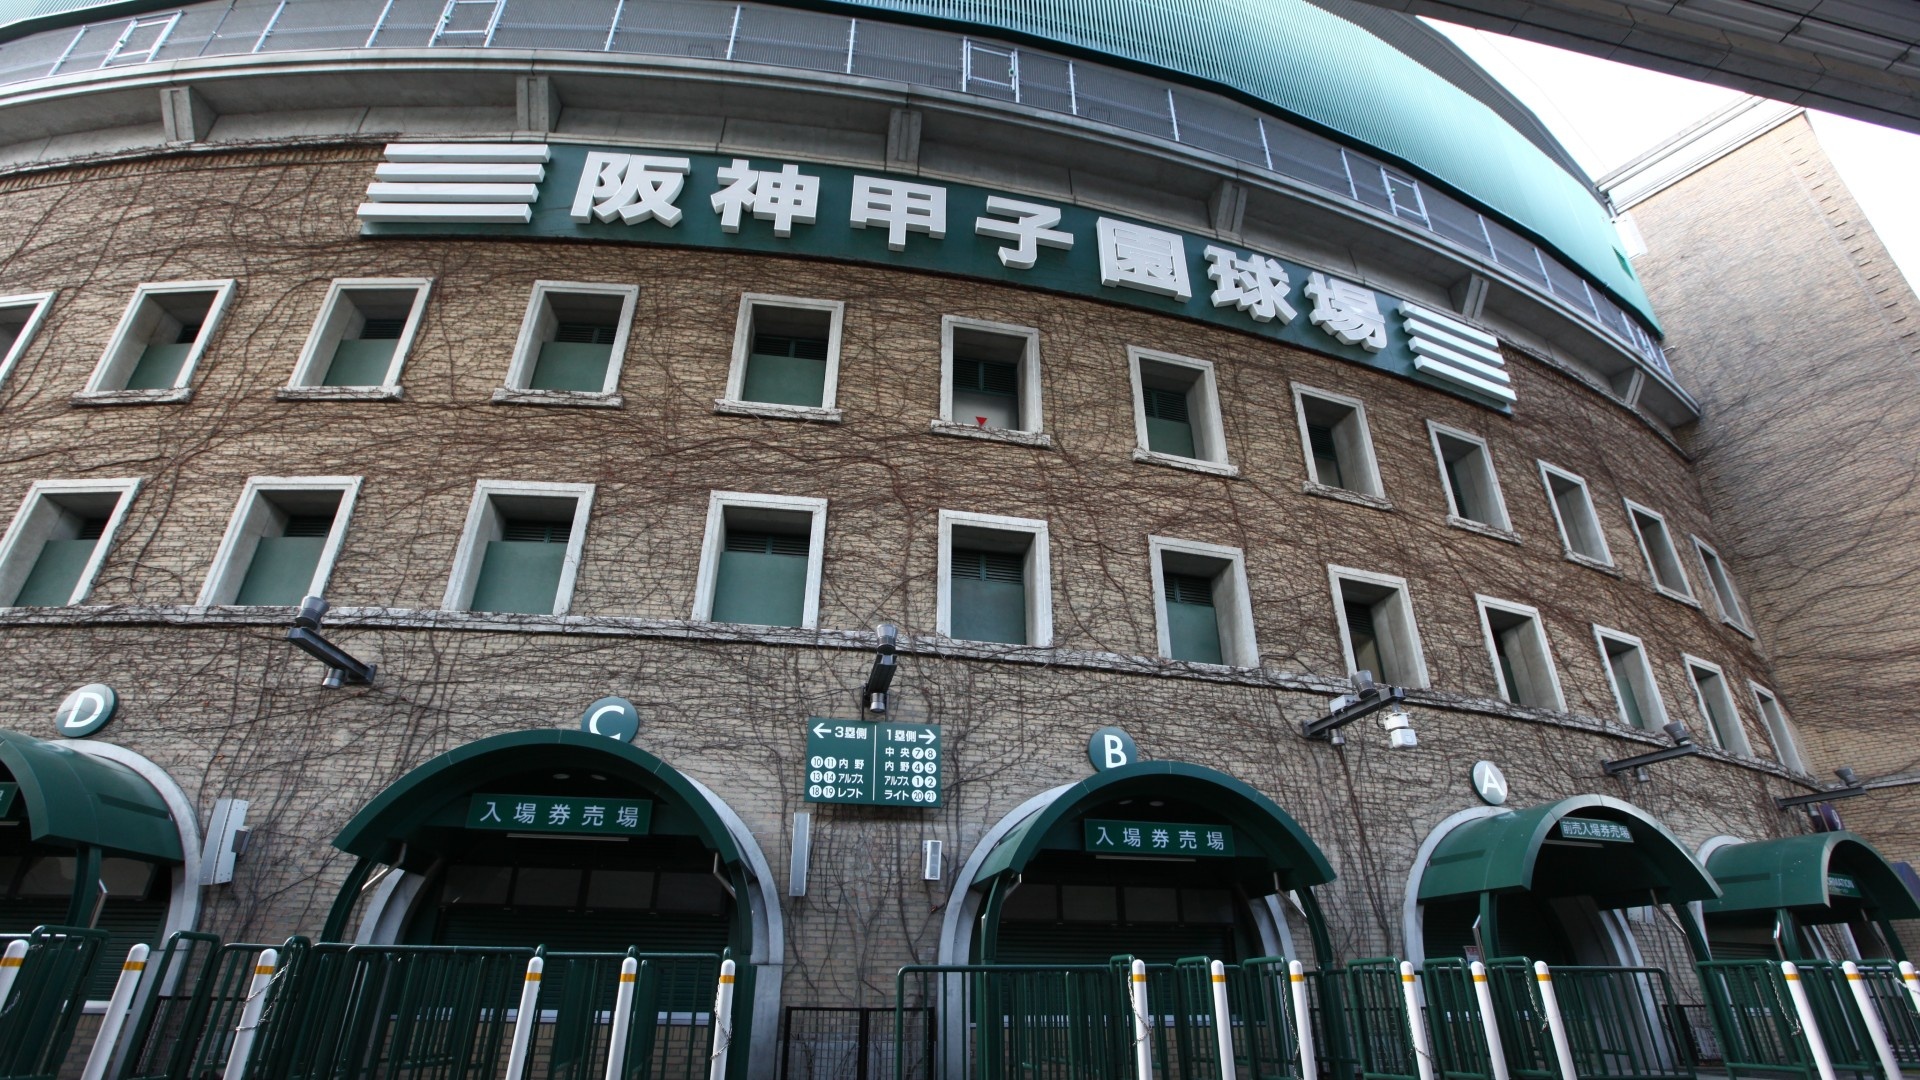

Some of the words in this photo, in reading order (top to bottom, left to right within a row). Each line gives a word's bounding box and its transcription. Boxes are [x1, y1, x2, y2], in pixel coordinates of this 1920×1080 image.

[571, 150, 1388, 353] 阪神甲子園球場
[64, 692, 105, 728] D
[589, 704, 625, 740] C
[834, 726, 867, 739] 3塁側
[886, 729, 917, 742] 1塁側
[885, 747, 910, 758] 中央
[1104, 734, 1127, 769] B
[838, 758, 864, 769] 内野
[885, 761, 910, 772] 内野
[838, 773, 864, 784] アルプス
[884, 775, 910, 786] アルプス
[1482, 764, 1505, 796] A
[838, 787, 864, 799] レフト
[884, 789, 910, 801] ライト
[480, 801, 639, 828] 入場券売場
[1562, 821, 1631, 839] 前売入場券売場
[1096, 826, 1224, 850] 入場券売場
